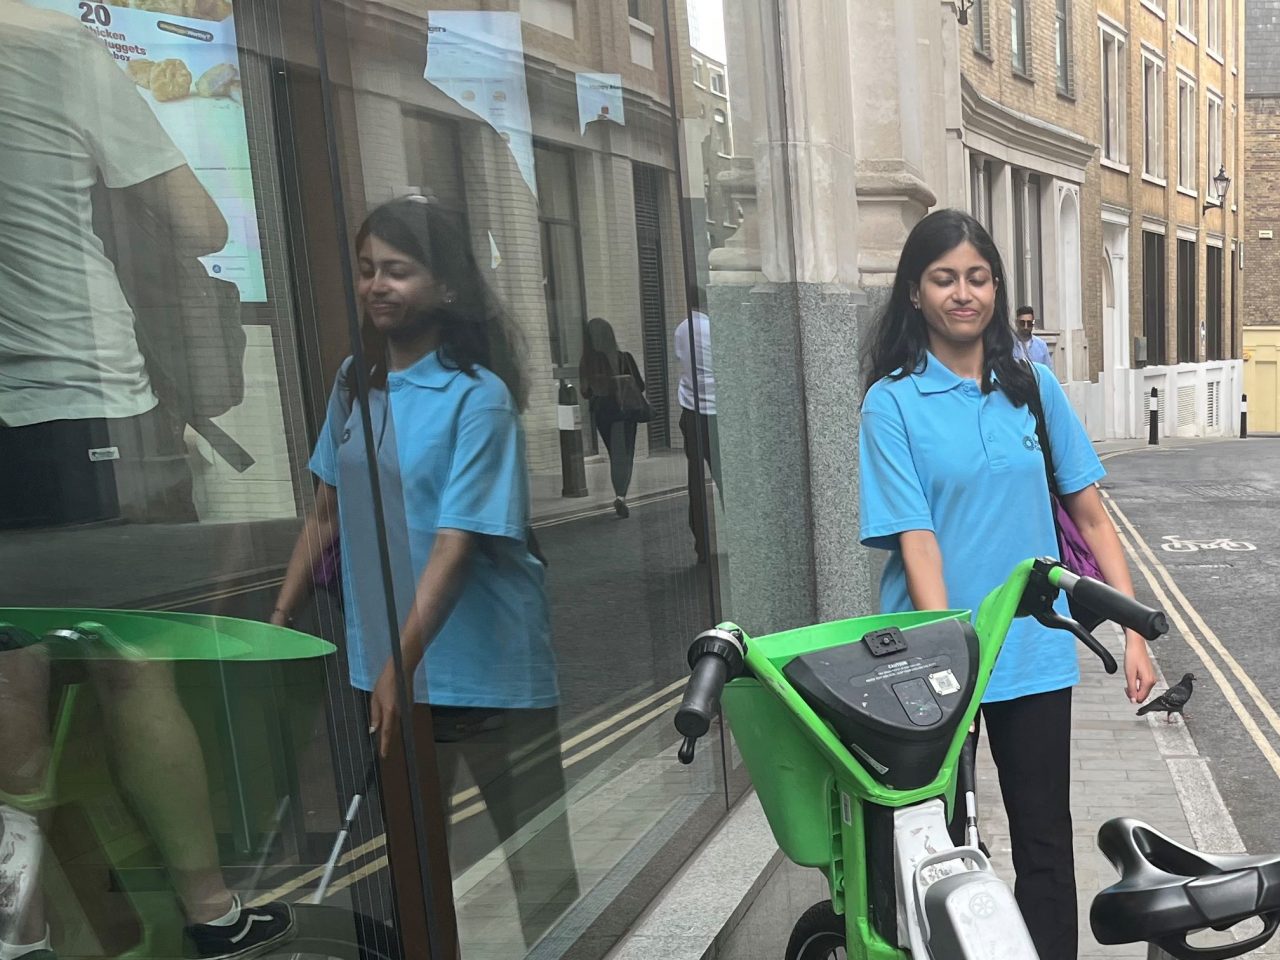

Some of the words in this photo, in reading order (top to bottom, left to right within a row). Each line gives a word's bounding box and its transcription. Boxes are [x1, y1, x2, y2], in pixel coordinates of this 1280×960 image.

[78, 1, 111, 27] 20
[84, 25, 126, 41] hicken
[113, 51, 131, 62] box
